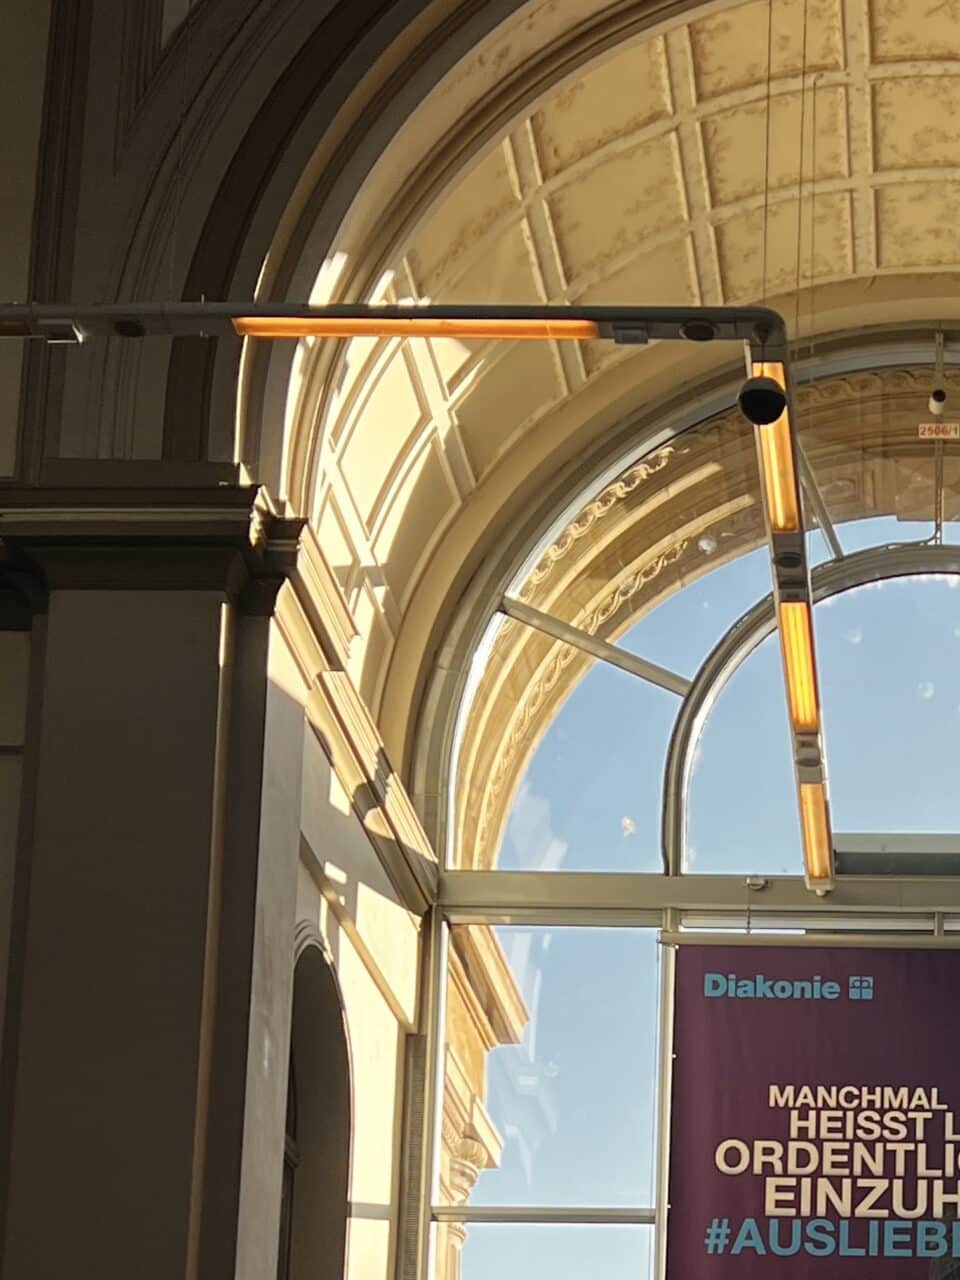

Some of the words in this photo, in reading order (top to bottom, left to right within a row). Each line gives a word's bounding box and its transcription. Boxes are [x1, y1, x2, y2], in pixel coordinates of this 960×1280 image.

[704, 973, 840, 999] Diakonie
[768, 1084, 948, 1110] MANCHMAL
[789, 1110, 932, 1141] HEISST
